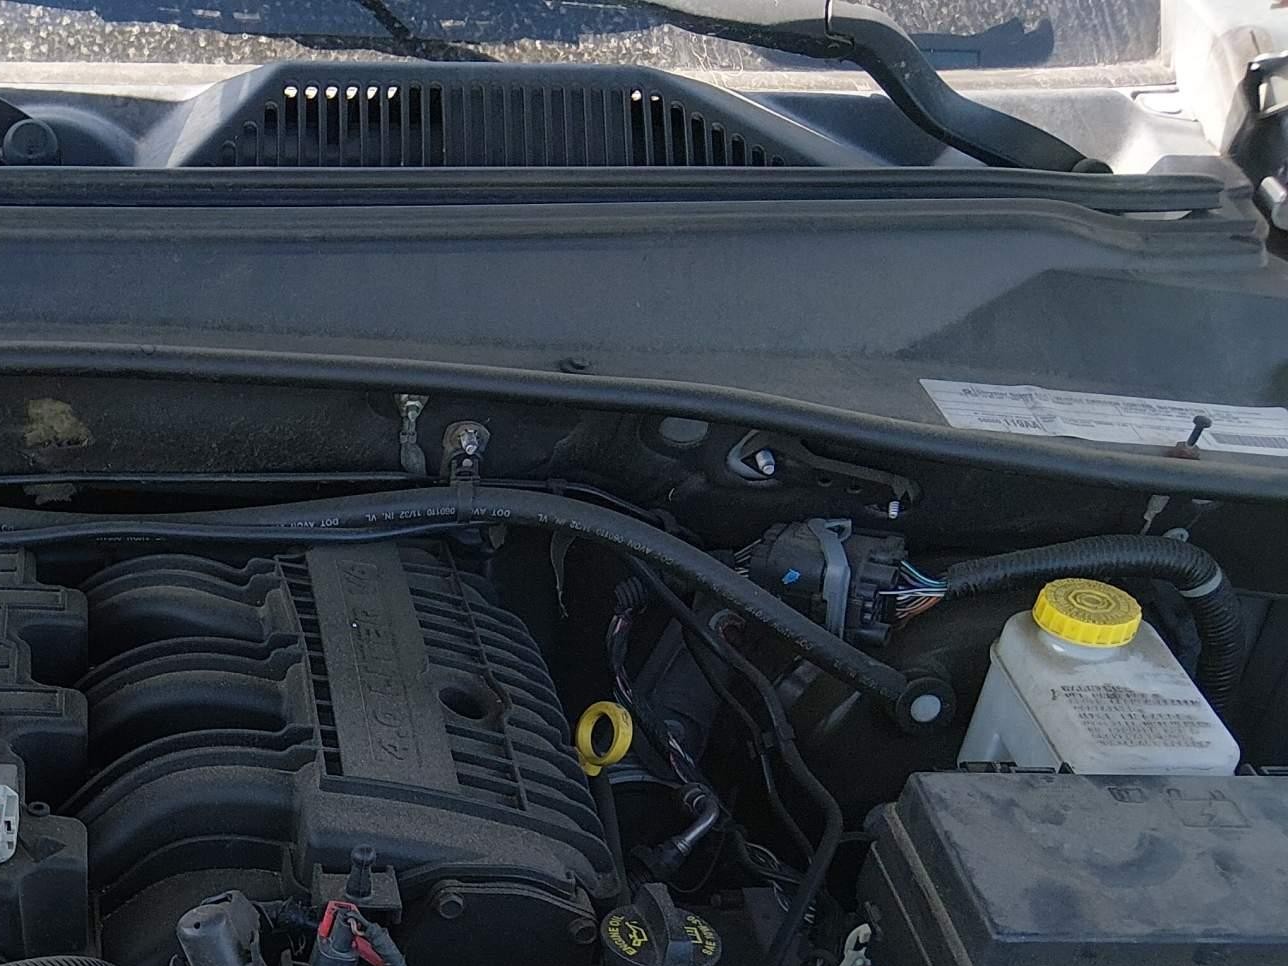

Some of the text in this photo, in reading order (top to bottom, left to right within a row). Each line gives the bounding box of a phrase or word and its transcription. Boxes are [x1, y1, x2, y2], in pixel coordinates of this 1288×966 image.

[364, 512, 378, 521] VL
[399, 508, 422, 519] 11/32
[426, 506, 456, 517] 060110
[491, 508, 511, 518] DOT
[320, 518, 339, 527] DOT
[626, 540, 652, 555] AVON
[608, 915, 638, 956] ENGINE OIL
